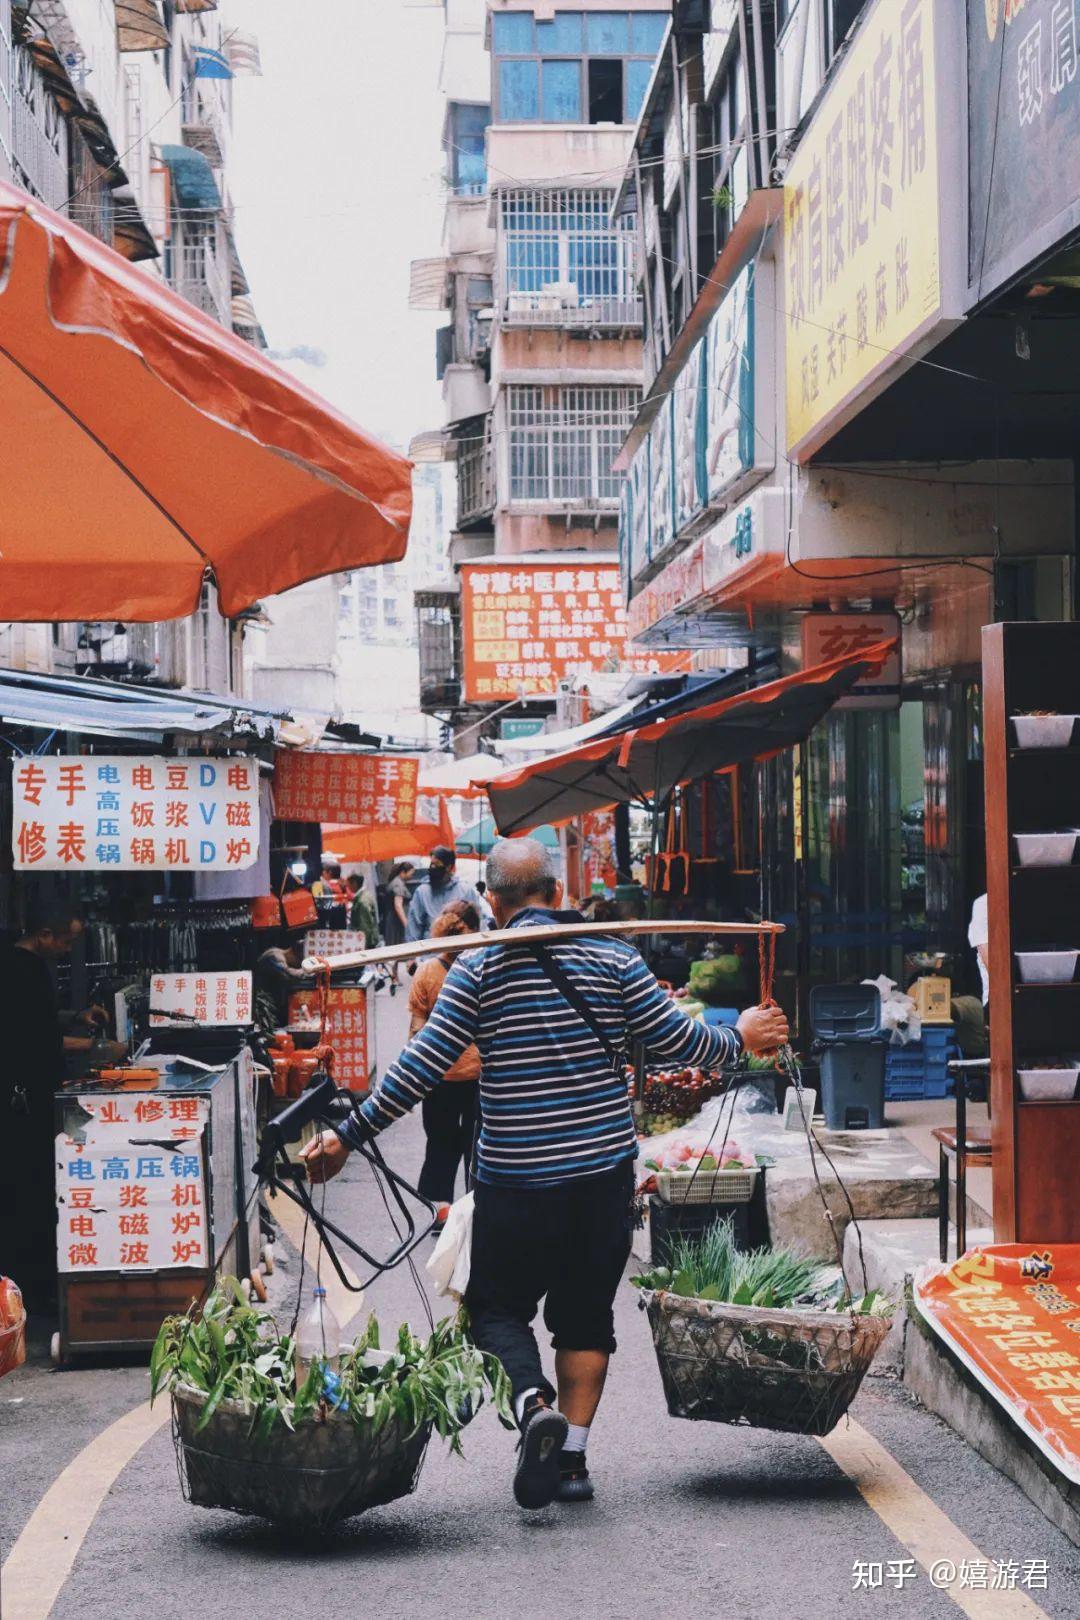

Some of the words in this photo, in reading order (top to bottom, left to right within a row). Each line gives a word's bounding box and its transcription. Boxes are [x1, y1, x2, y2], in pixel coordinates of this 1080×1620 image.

[875, 261, 888, 335] 麻
[17, 764, 47, 864] 专修
[57, 764, 86, 863] 手表
[96, 764, 121, 864] 电高压锅
[130, 764, 155, 864] 电饭锅
[165, 766, 190, 864] 豆浆机
[200, 764, 216, 863] DVD
[226, 764, 251, 864] 电磁炉
[375, 760, 399, 824] 手表
[216, 977, 229, 1020] 豆浆机
[236, 977, 249, 1020] 电磁炉
[68, 1156, 200, 1180] 电高压锅
[68, 1184, 201, 1208] 豆浆机
[68, 1241, 201, 1266] 微波炉
[69, 1212, 200, 1237] 电磁炉
